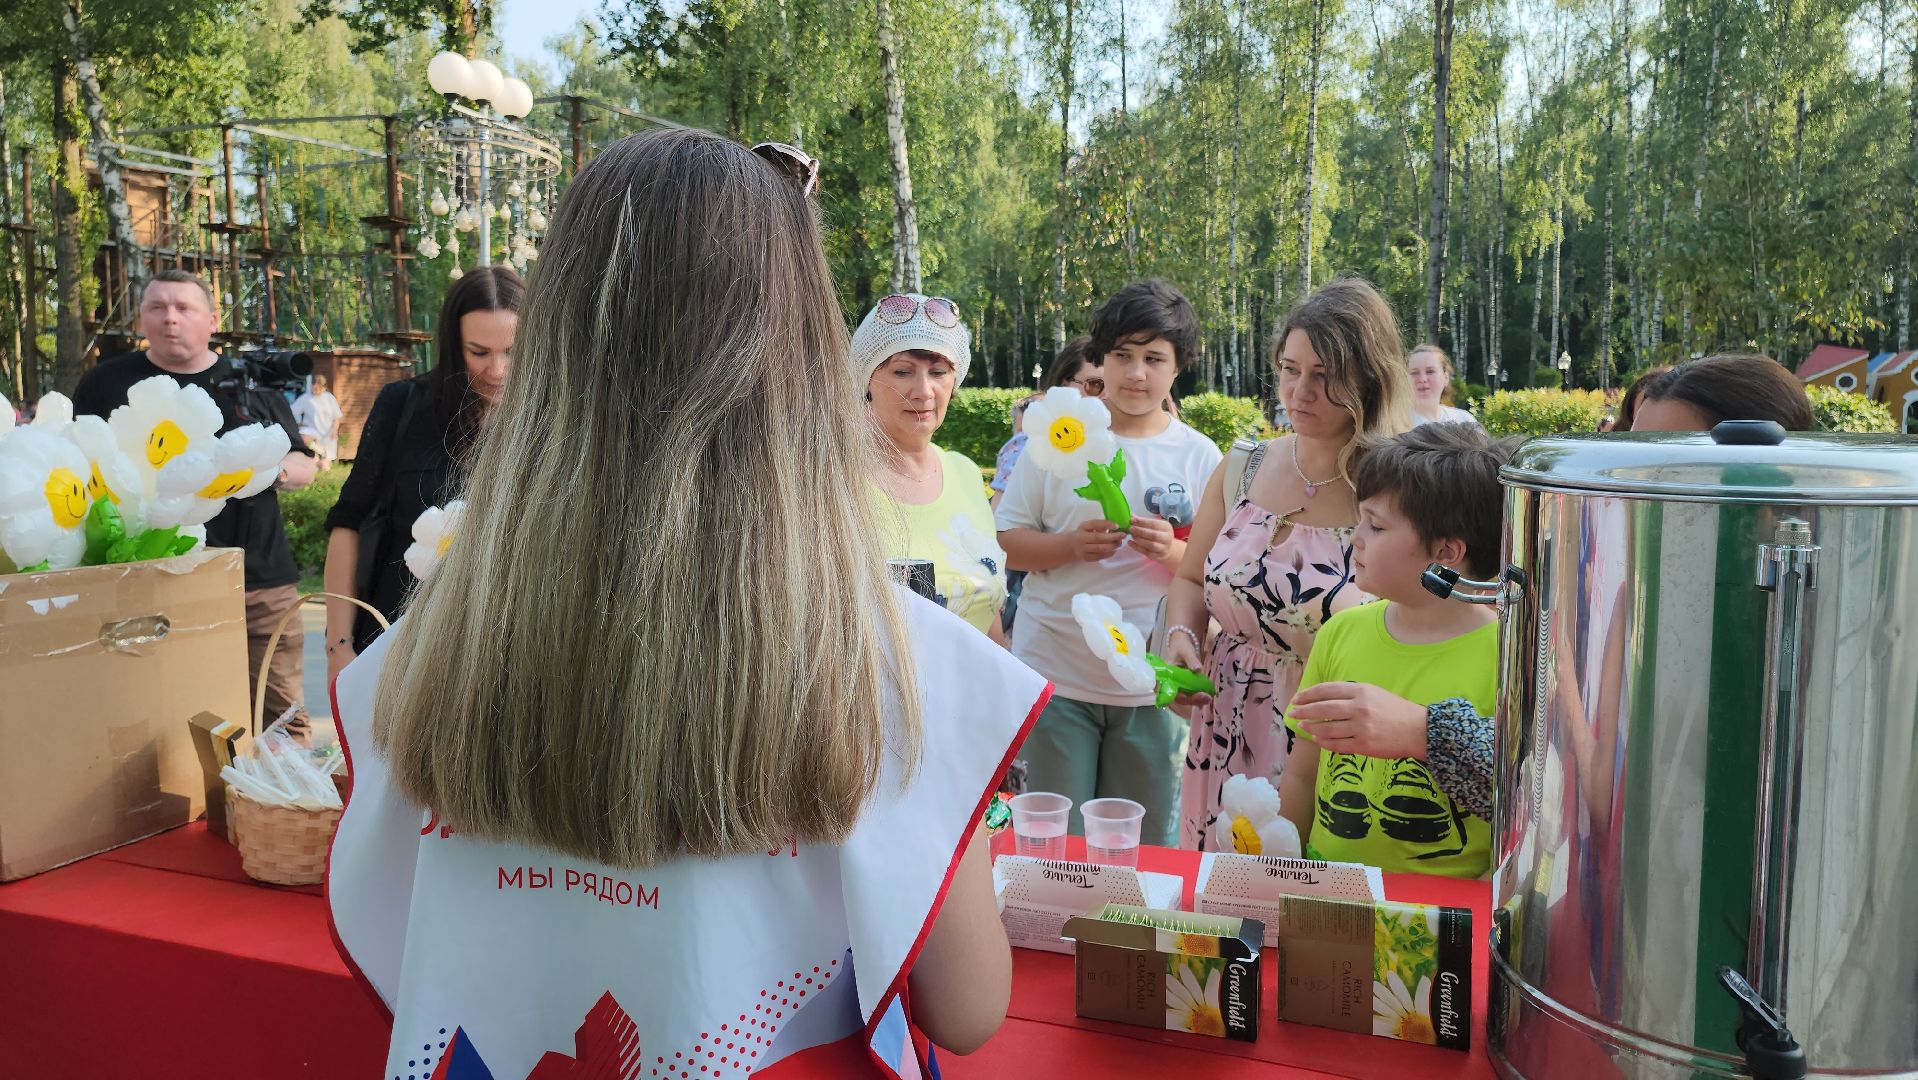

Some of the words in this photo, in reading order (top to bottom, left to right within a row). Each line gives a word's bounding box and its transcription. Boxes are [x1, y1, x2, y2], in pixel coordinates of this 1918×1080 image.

[498, 866, 553, 889] МЫ
[565, 868, 659, 910] РЯДОМ
[1229, 963, 1247, 1031] Greenfield
[1440, 971, 1459, 1038] Greenfield
